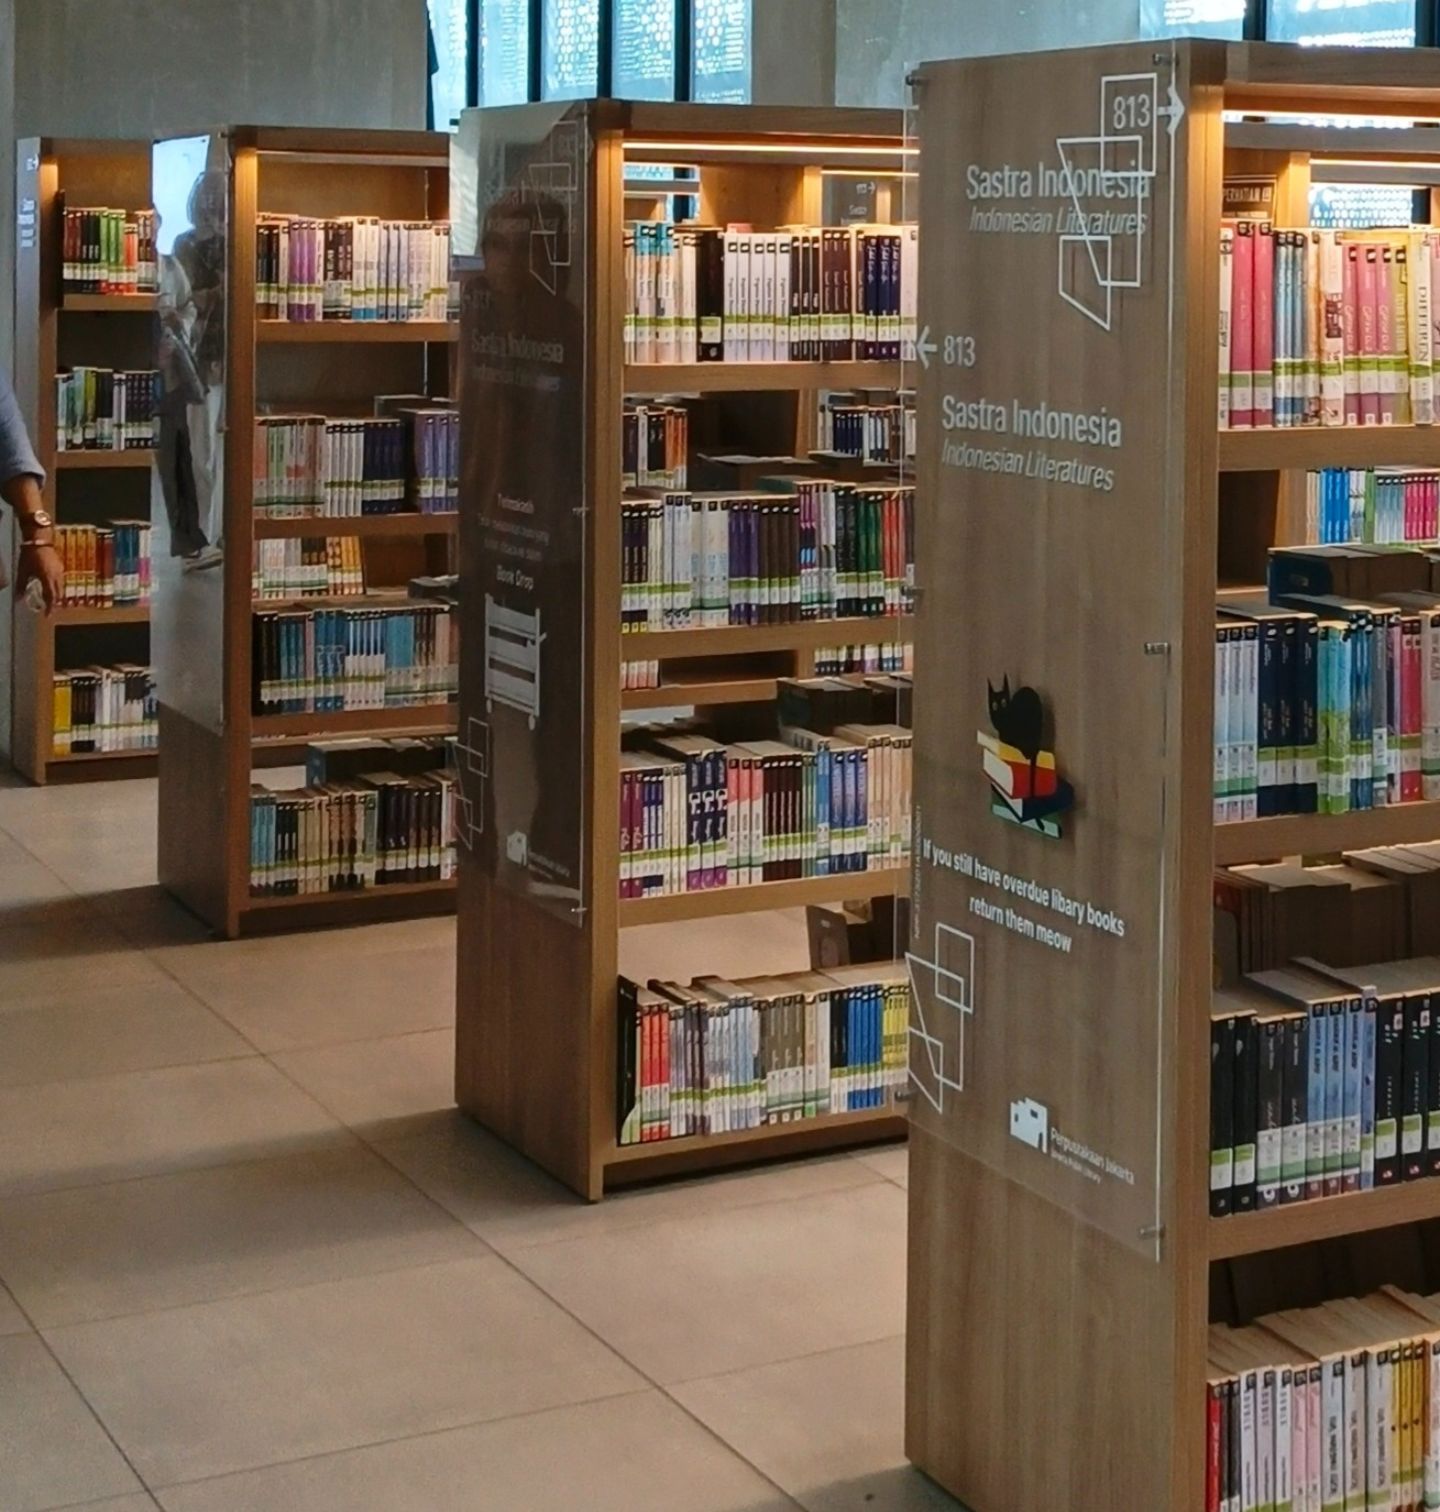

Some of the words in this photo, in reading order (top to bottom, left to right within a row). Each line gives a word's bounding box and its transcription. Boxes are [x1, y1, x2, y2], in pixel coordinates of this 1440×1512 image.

[1113, 95, 1151, 129] 813
[966, 163, 1033, 200] Sastra
[1038, 160, 1151, 199] Indonesia
[970, 206, 1053, 234] Indonesian
[1056, 208, 1148, 236] Literatures
[943, 336, 975, 367] 813
[942, 395, 1007, 434] Sastra
[1013, 399, 1122, 447] Indonesia
[942, 443, 1024, 476] Indonesian
[1026, 451, 1115, 491] Literatures
[923, 838, 933, 859] If
[932, 846, 951, 867] you
[953, 853, 972, 876] still
[975, 858, 1001, 886] have
[1002, 873, 1049, 906] overdue
[1051, 887, 1086, 926] libary
[1087, 902, 1125, 937] books
[969, 896, 1003, 925] return
[1005, 909, 1034, 939] them
[1036, 924, 1073, 953] meow
